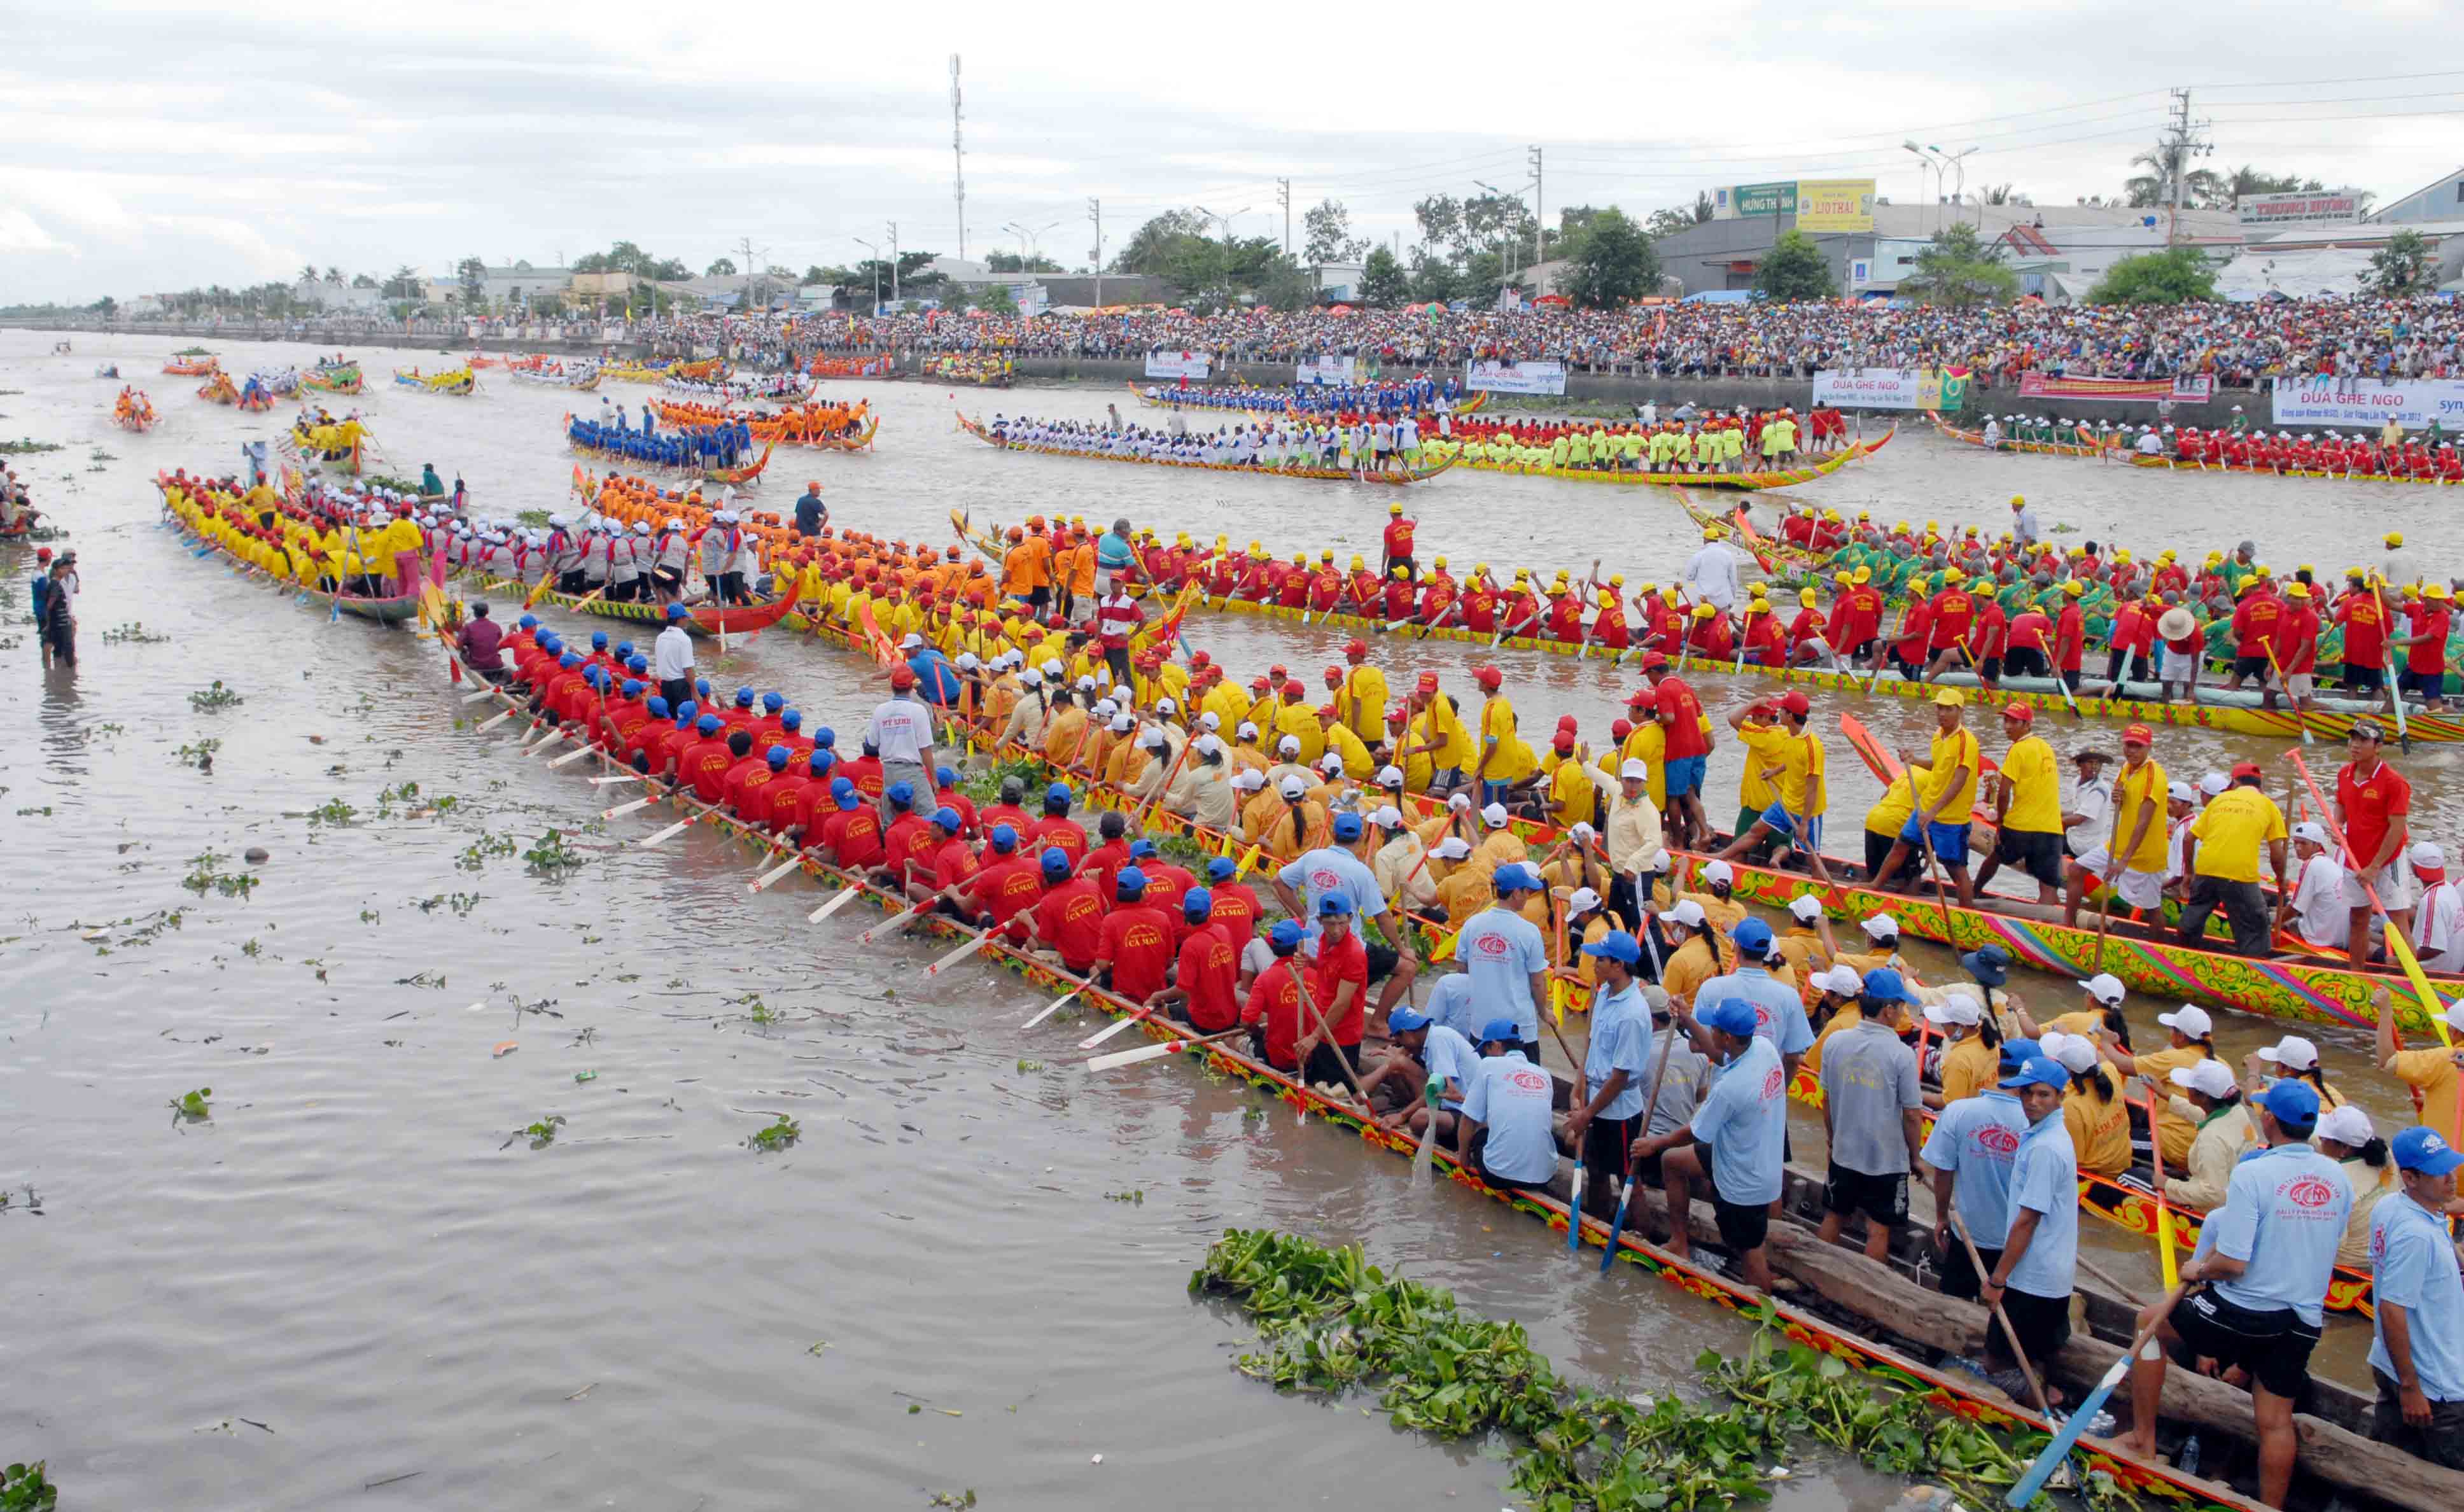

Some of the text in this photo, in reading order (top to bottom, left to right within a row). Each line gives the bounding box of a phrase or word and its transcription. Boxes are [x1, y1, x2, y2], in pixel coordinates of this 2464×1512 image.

[1856, 381, 1874, 390] GHE
[1878, 381, 1900, 391] NGO
[2372, 395, 2404, 406] NGO
[1228, 908, 1248, 916] MAU
